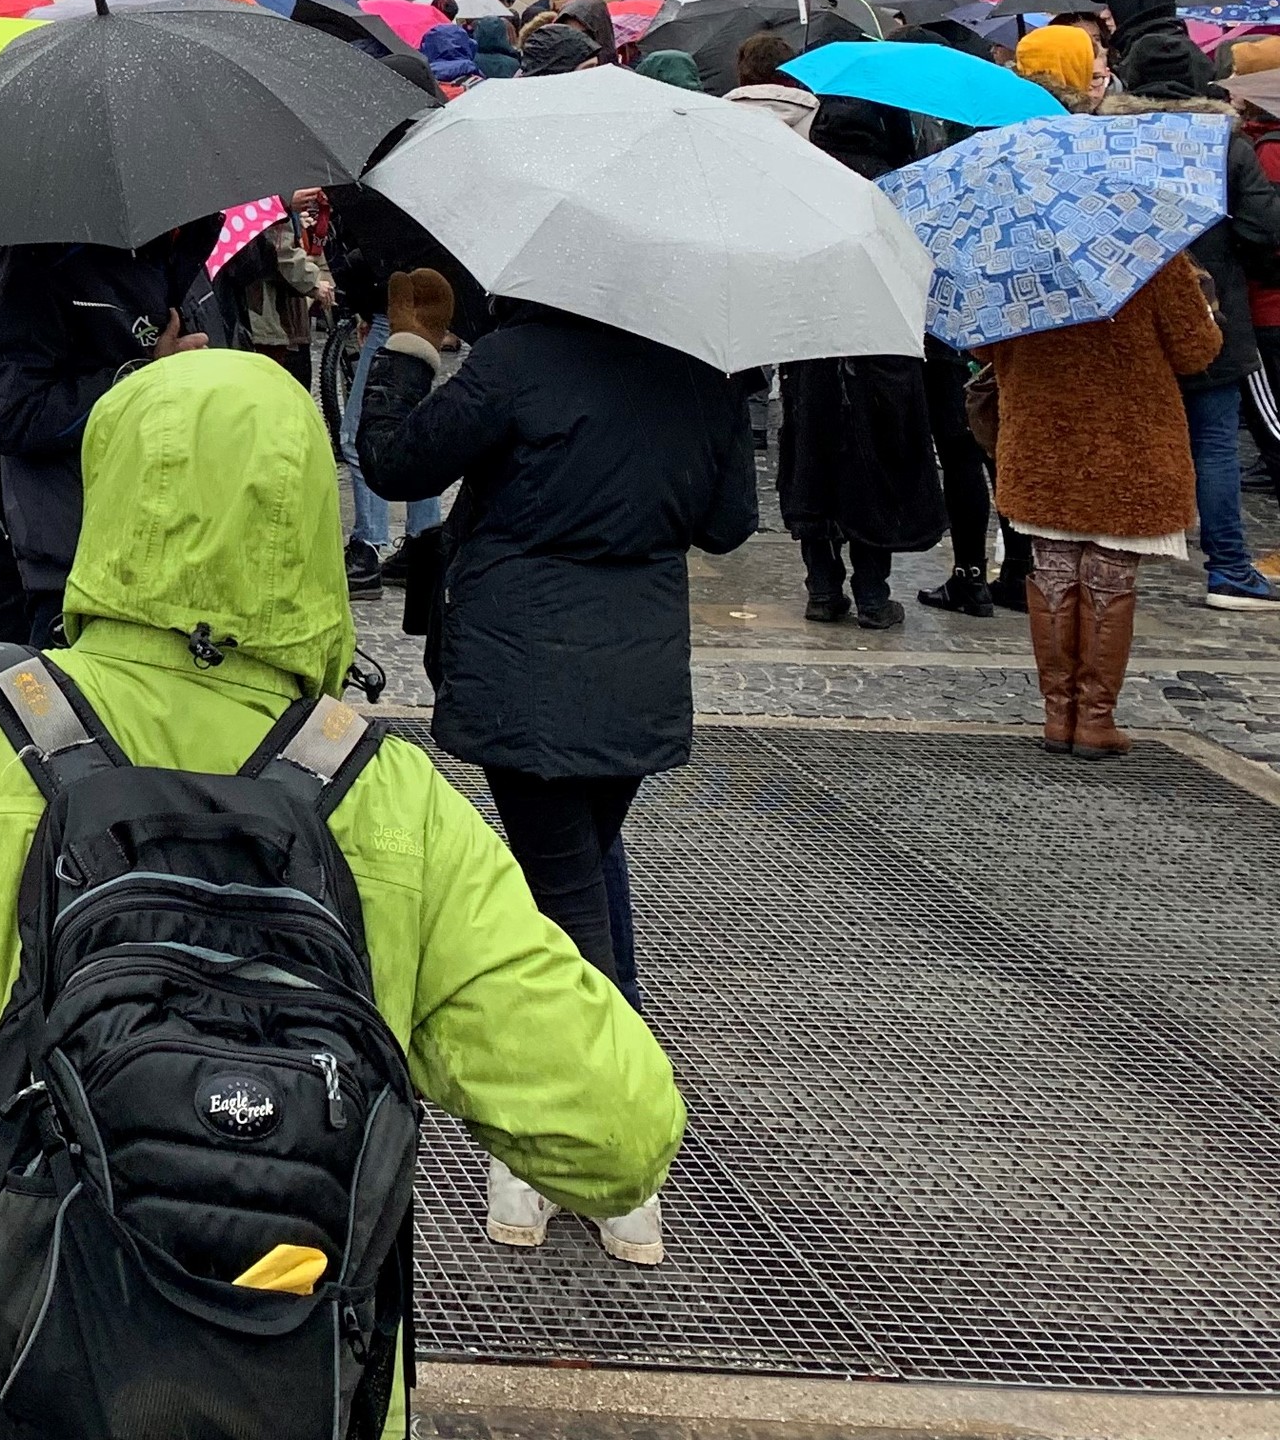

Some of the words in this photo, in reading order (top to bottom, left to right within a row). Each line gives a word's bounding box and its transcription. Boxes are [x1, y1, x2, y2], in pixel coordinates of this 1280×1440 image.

[373, 823, 413, 842] Jack
[209, 1090, 249, 1116] Eagle
[236, 1097, 274, 1125] Creek
